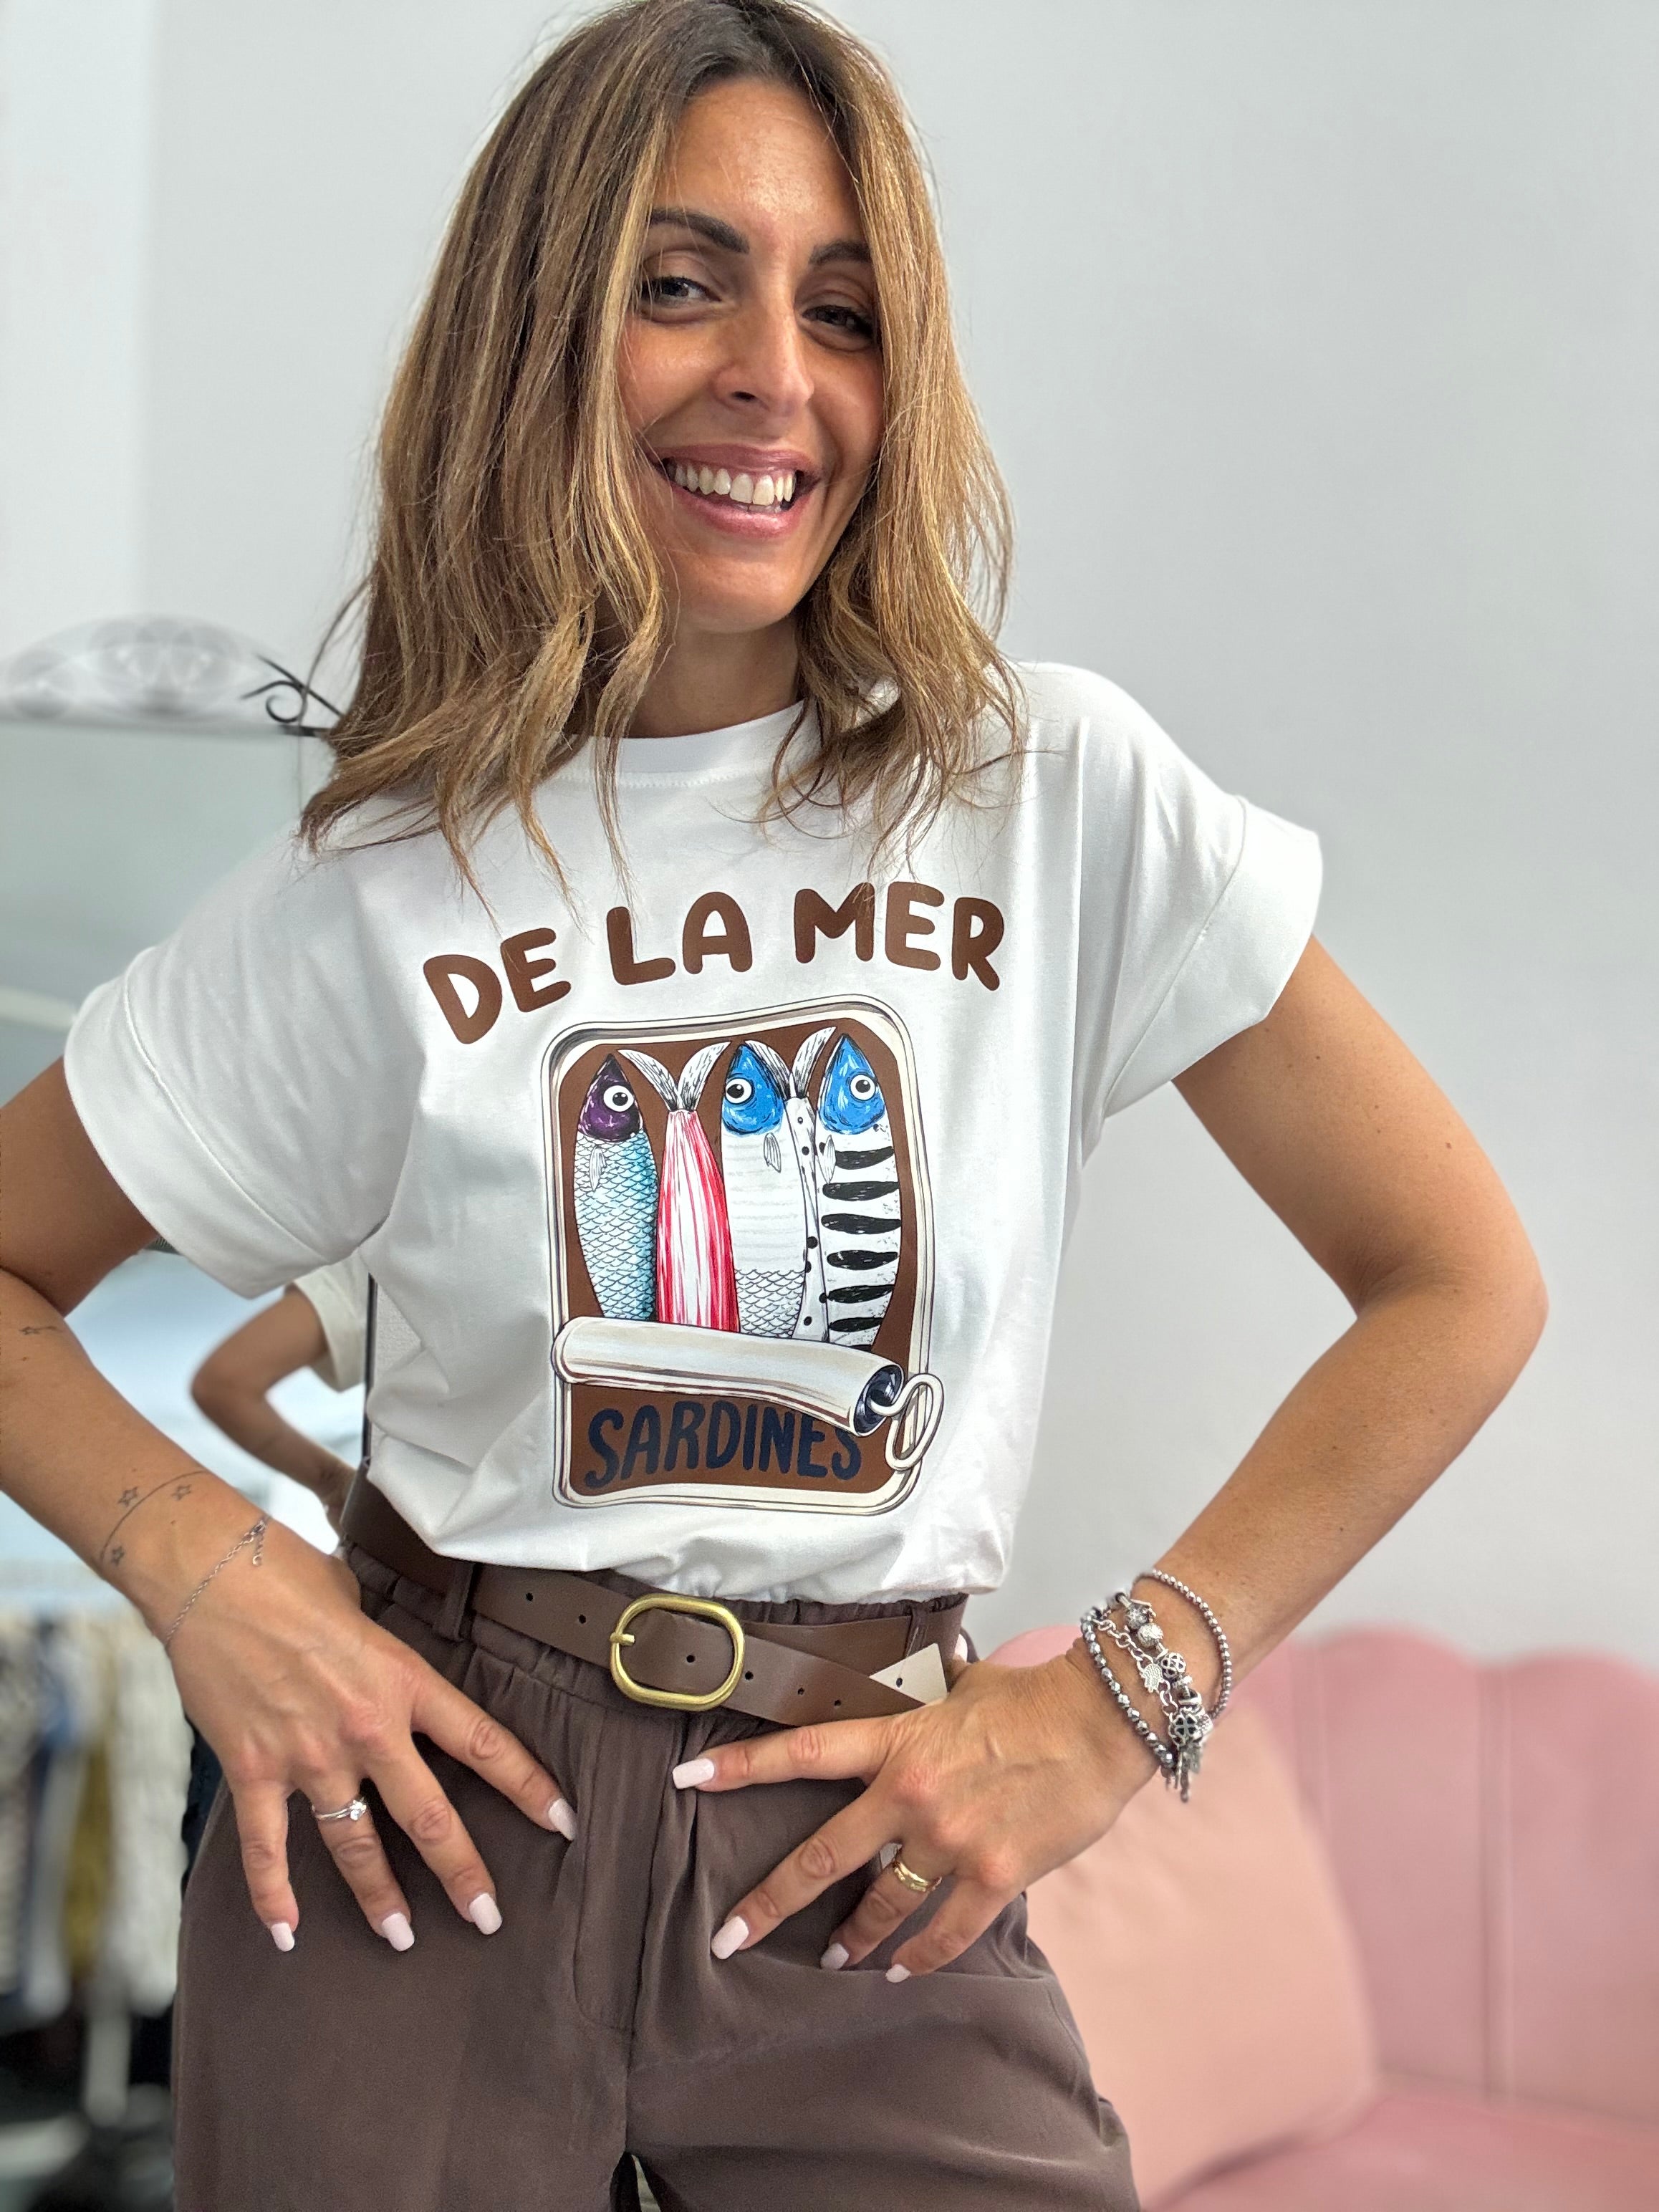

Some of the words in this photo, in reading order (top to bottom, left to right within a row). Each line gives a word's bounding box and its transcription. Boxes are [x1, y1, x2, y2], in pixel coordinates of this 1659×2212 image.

[423, 928, 572, 1044] DE
[606, 892, 752, 986] LA
[794, 882, 1004, 991] MER
[584, 1400, 862, 1489] SARDINES
